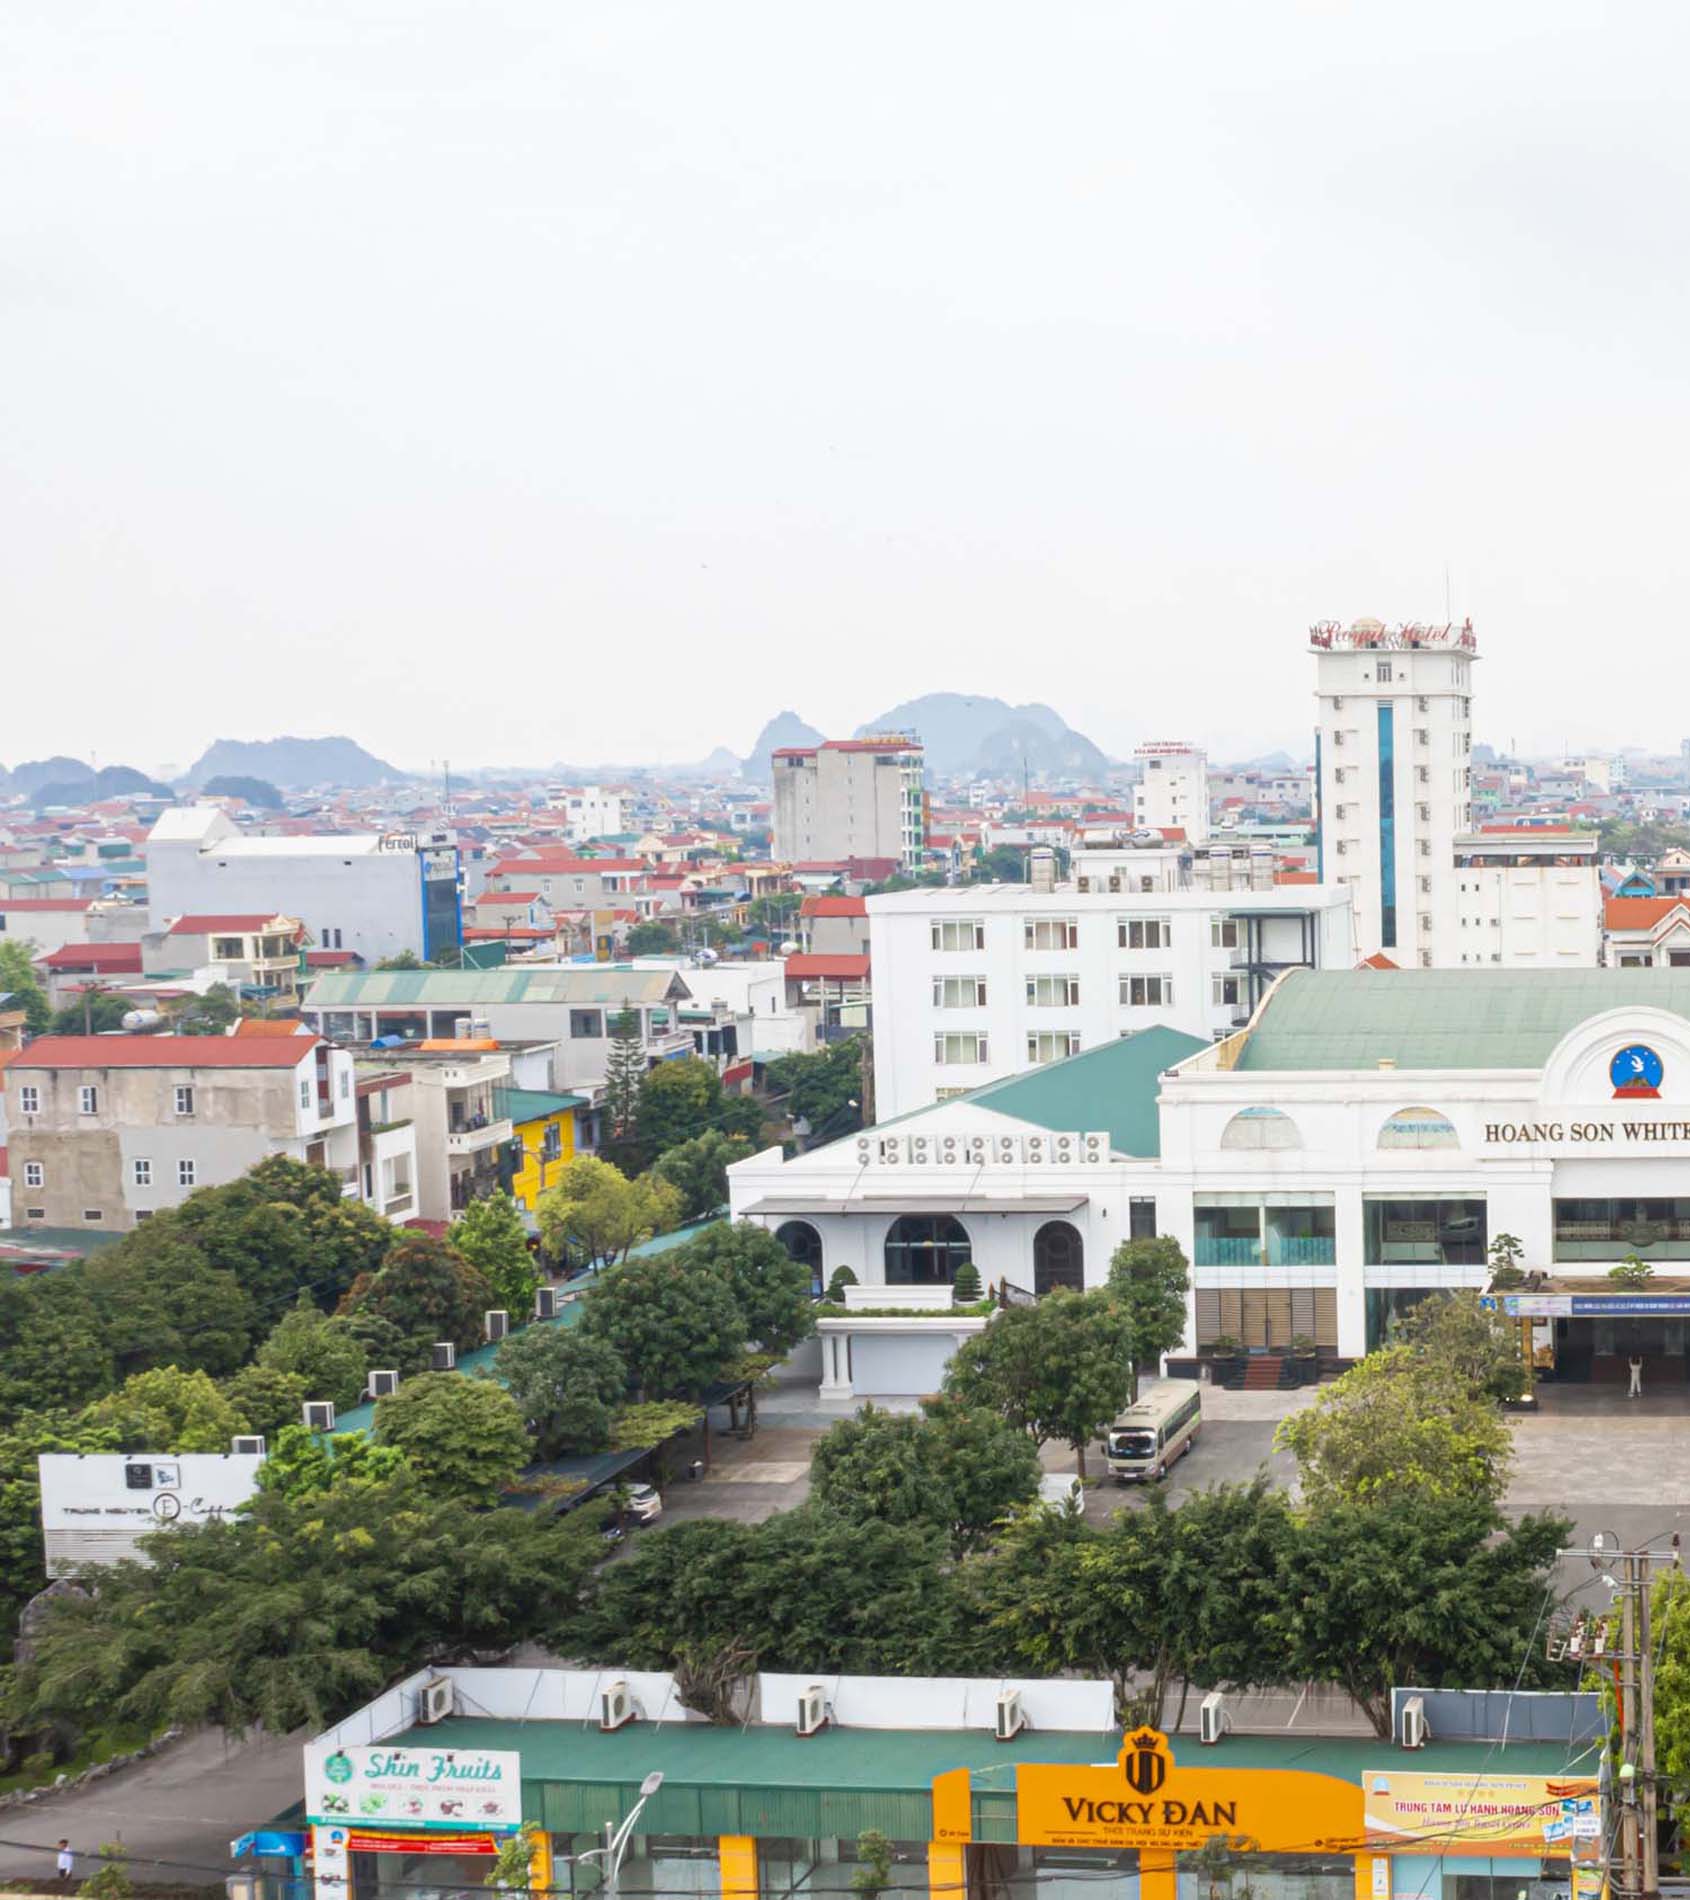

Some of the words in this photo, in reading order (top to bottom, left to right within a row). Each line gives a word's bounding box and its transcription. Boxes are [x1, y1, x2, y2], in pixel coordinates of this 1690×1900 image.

[1485, 1123, 1564, 1143] HOANG
[1570, 1123, 1614, 1142] SON
[365, 1753, 420, 1778] Shin
[426, 1756, 502, 1782] Fruits
[1062, 1797, 1155, 1825] VICKY
[1162, 1800, 1238, 1826] ĐAN
